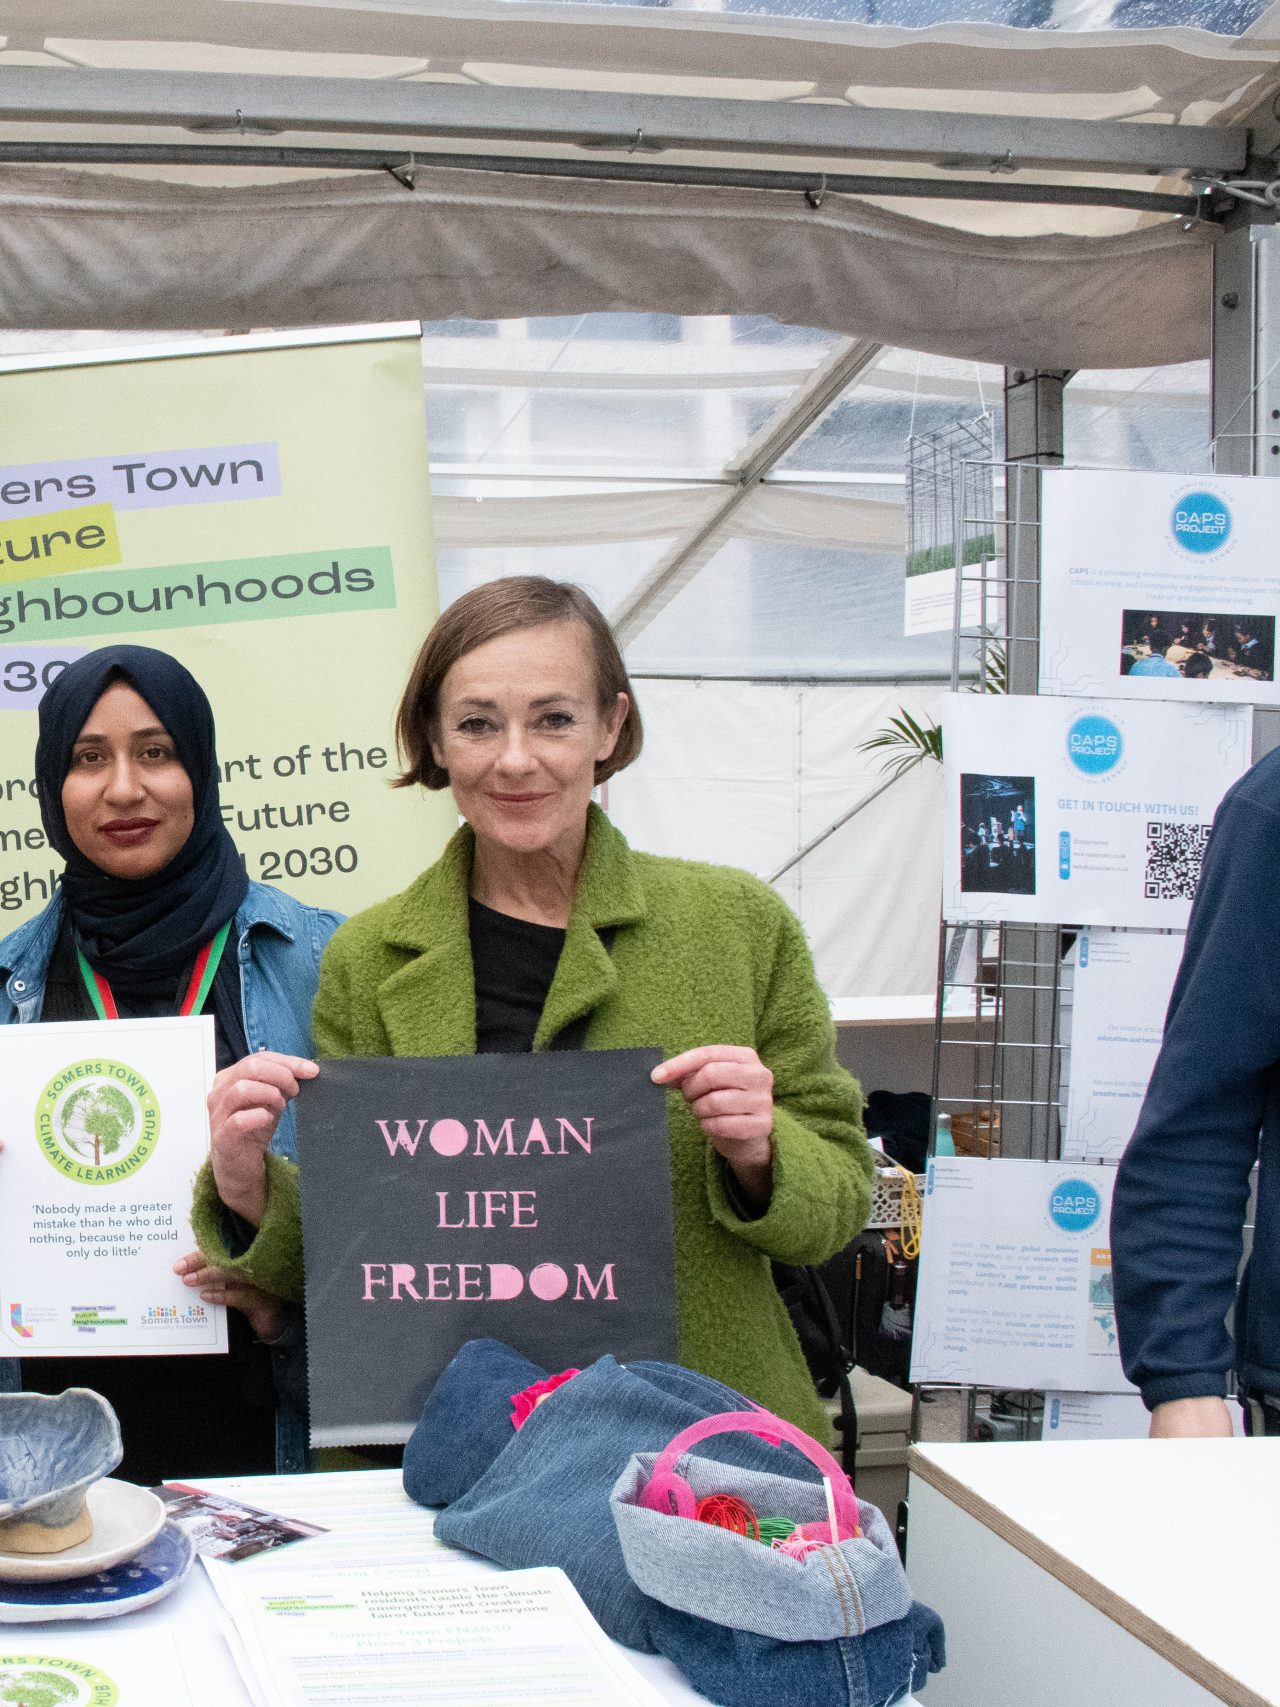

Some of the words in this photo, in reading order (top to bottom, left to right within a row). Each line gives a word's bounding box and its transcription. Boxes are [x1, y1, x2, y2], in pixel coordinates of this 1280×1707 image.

[113, 456, 265, 495] Town
[1176, 511, 1226, 525] CAPS
[1176, 524, 1226, 534] PROJECT
[1069, 567, 1089, 576] CAPS
[1071, 734, 1117, 748] CAPS
[1071, 746, 1117, 756] PROJECT
[217, 754, 262, 783] rt
[273, 744, 312, 777] of
[322, 742, 388, 772] the
[1058, 799, 1079, 810] GET
[1082, 800, 1094, 811] IN
[1097, 801, 1140, 813] TOUCH
[1144, 803, 1176, 815] WITH
[1180, 805, 1199, 817] US!
[259, 844, 358, 880] 2030
[47, 1063, 102, 1099] SOMERS
[108, 1065, 148, 1097] TOWN
[375, 1117, 595, 1156] WOMAN
[40, 1113, 73, 1172] CLIMATE
[77, 1145, 148, 1181] LEARNING
[143, 1109, 156, 1141] HUB
[84, 1203, 116, 1213] made
[120, 1204, 126, 1212] a
[130, 1202, 172, 1214] greater
[1053, 1195, 1097, 1208] CAPS
[435, 1190, 539, 1228] LIFE
[1053, 1206, 1096, 1216] PROJECT
[33, 1218, 76, 1229] mistake
[80, 1217, 105, 1228] than
[108, 1217, 122, 1227] he
[127, 1216, 150, 1226] who
[154, 1216, 173, 1226] did
[29, 1233, 76, 1245] nothing,
[79, 1232, 126, 1243] because
[129, 1231, 143, 1241] he
[147, 1230, 178, 1241] could
[66, 1248, 90, 1260] only
[93, 1247, 108, 1257] do
[360, 1262, 618, 1301] FREEDOM
[141, 1314, 179, 1325] Somers
[180, 1314, 208, 1324] Town
[361, 1589, 414, 1599] Helping
[418, 1587, 470, 1597] Somers
[474, 1583, 510, 1592] Town
[364, 1595, 427, 1605] residents
[430, 1592, 472, 1602] tackle
[477, 1590, 499, 1599] the
[502, 1587, 552, 1598] climate
[368, 1602, 444, 1612] emergency
[448, 1600, 474, 1608] and
[478, 1599, 522, 1607] create
[371, 1611, 407, 1619] fairer
[412, 1608, 455, 1618] future
[460, 1607, 479, 1616] for
[484, 1605, 549, 1616] everyone
[329, 1629, 391, 1640] Somers
[397, 1627, 440, 1638] Town
[446, 1624, 512, 1636] FN2030
[356, 1638, 407, 1648] Phase
[427, 1634, 496, 1647] Projects
[37, 1658, 96, 1678] TOWN
